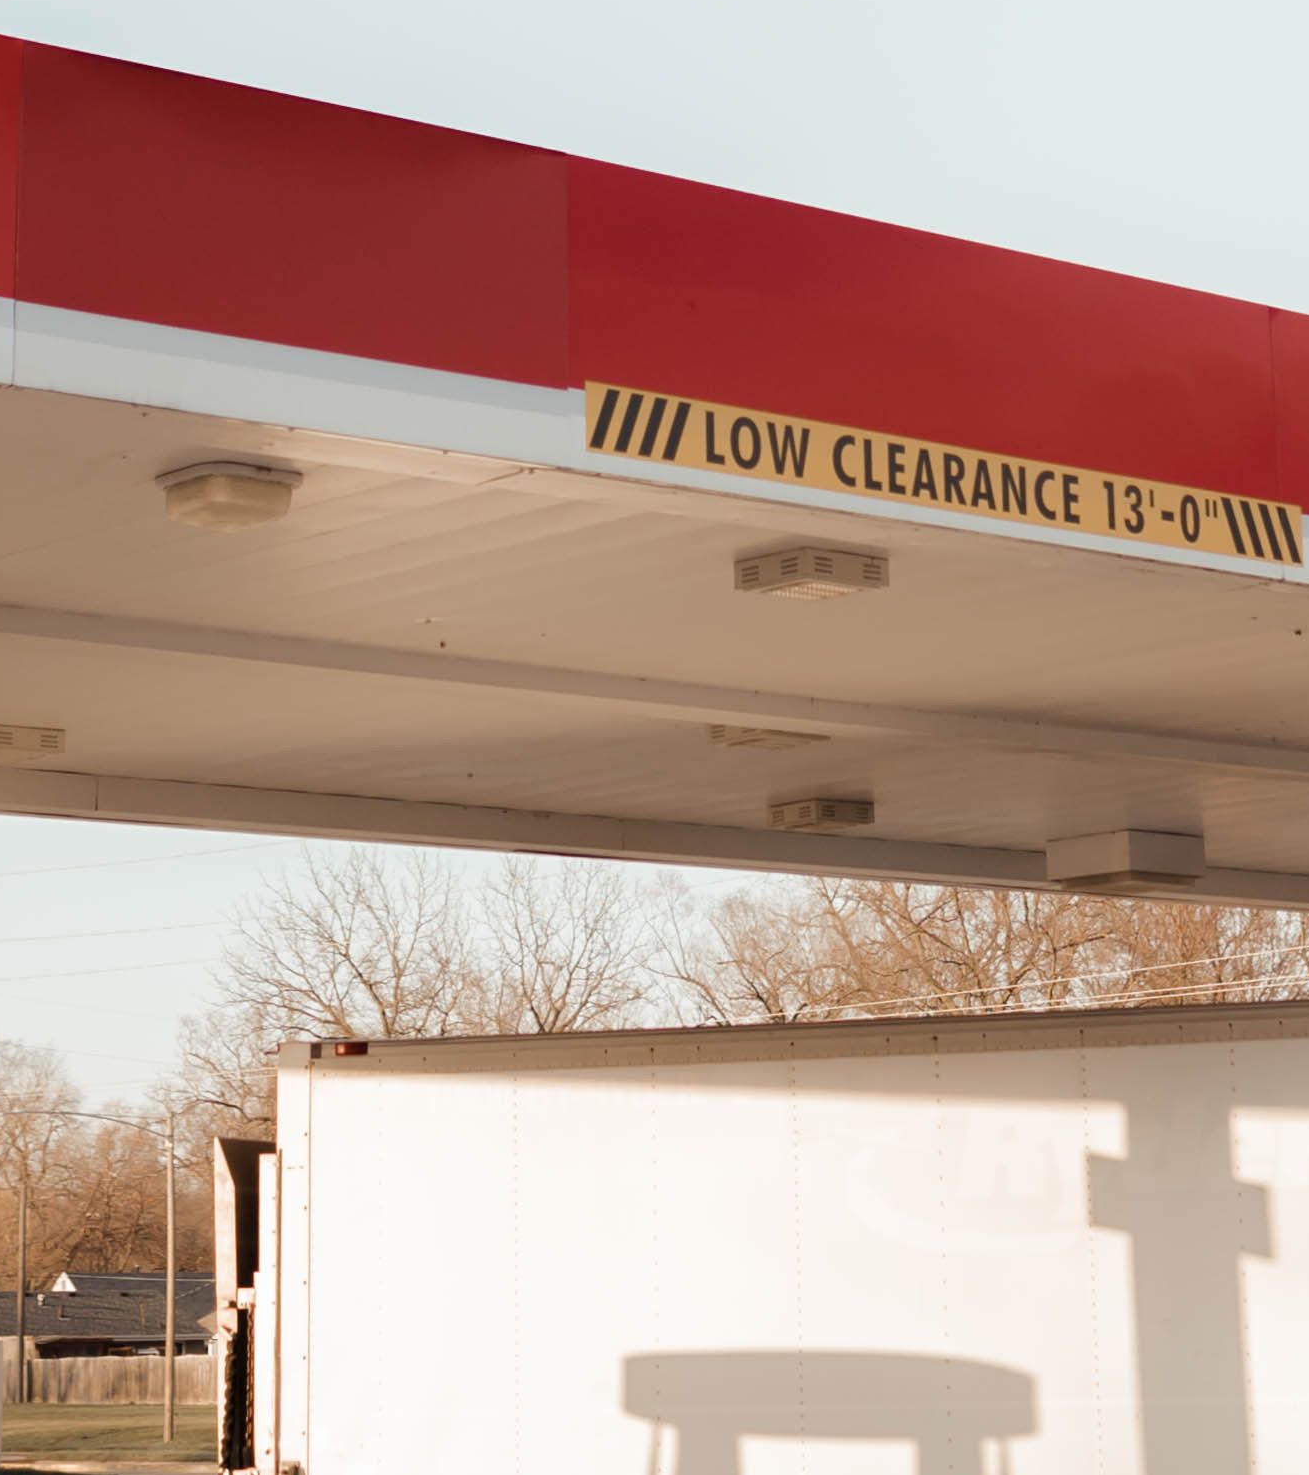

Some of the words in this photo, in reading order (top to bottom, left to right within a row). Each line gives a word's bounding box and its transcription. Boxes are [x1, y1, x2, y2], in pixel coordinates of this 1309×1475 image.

[705, 411, 810, 478] LOW
[833, 435, 1080, 524] CLEARANCE
[1103, 481, 1218, 543] 13'-0"
